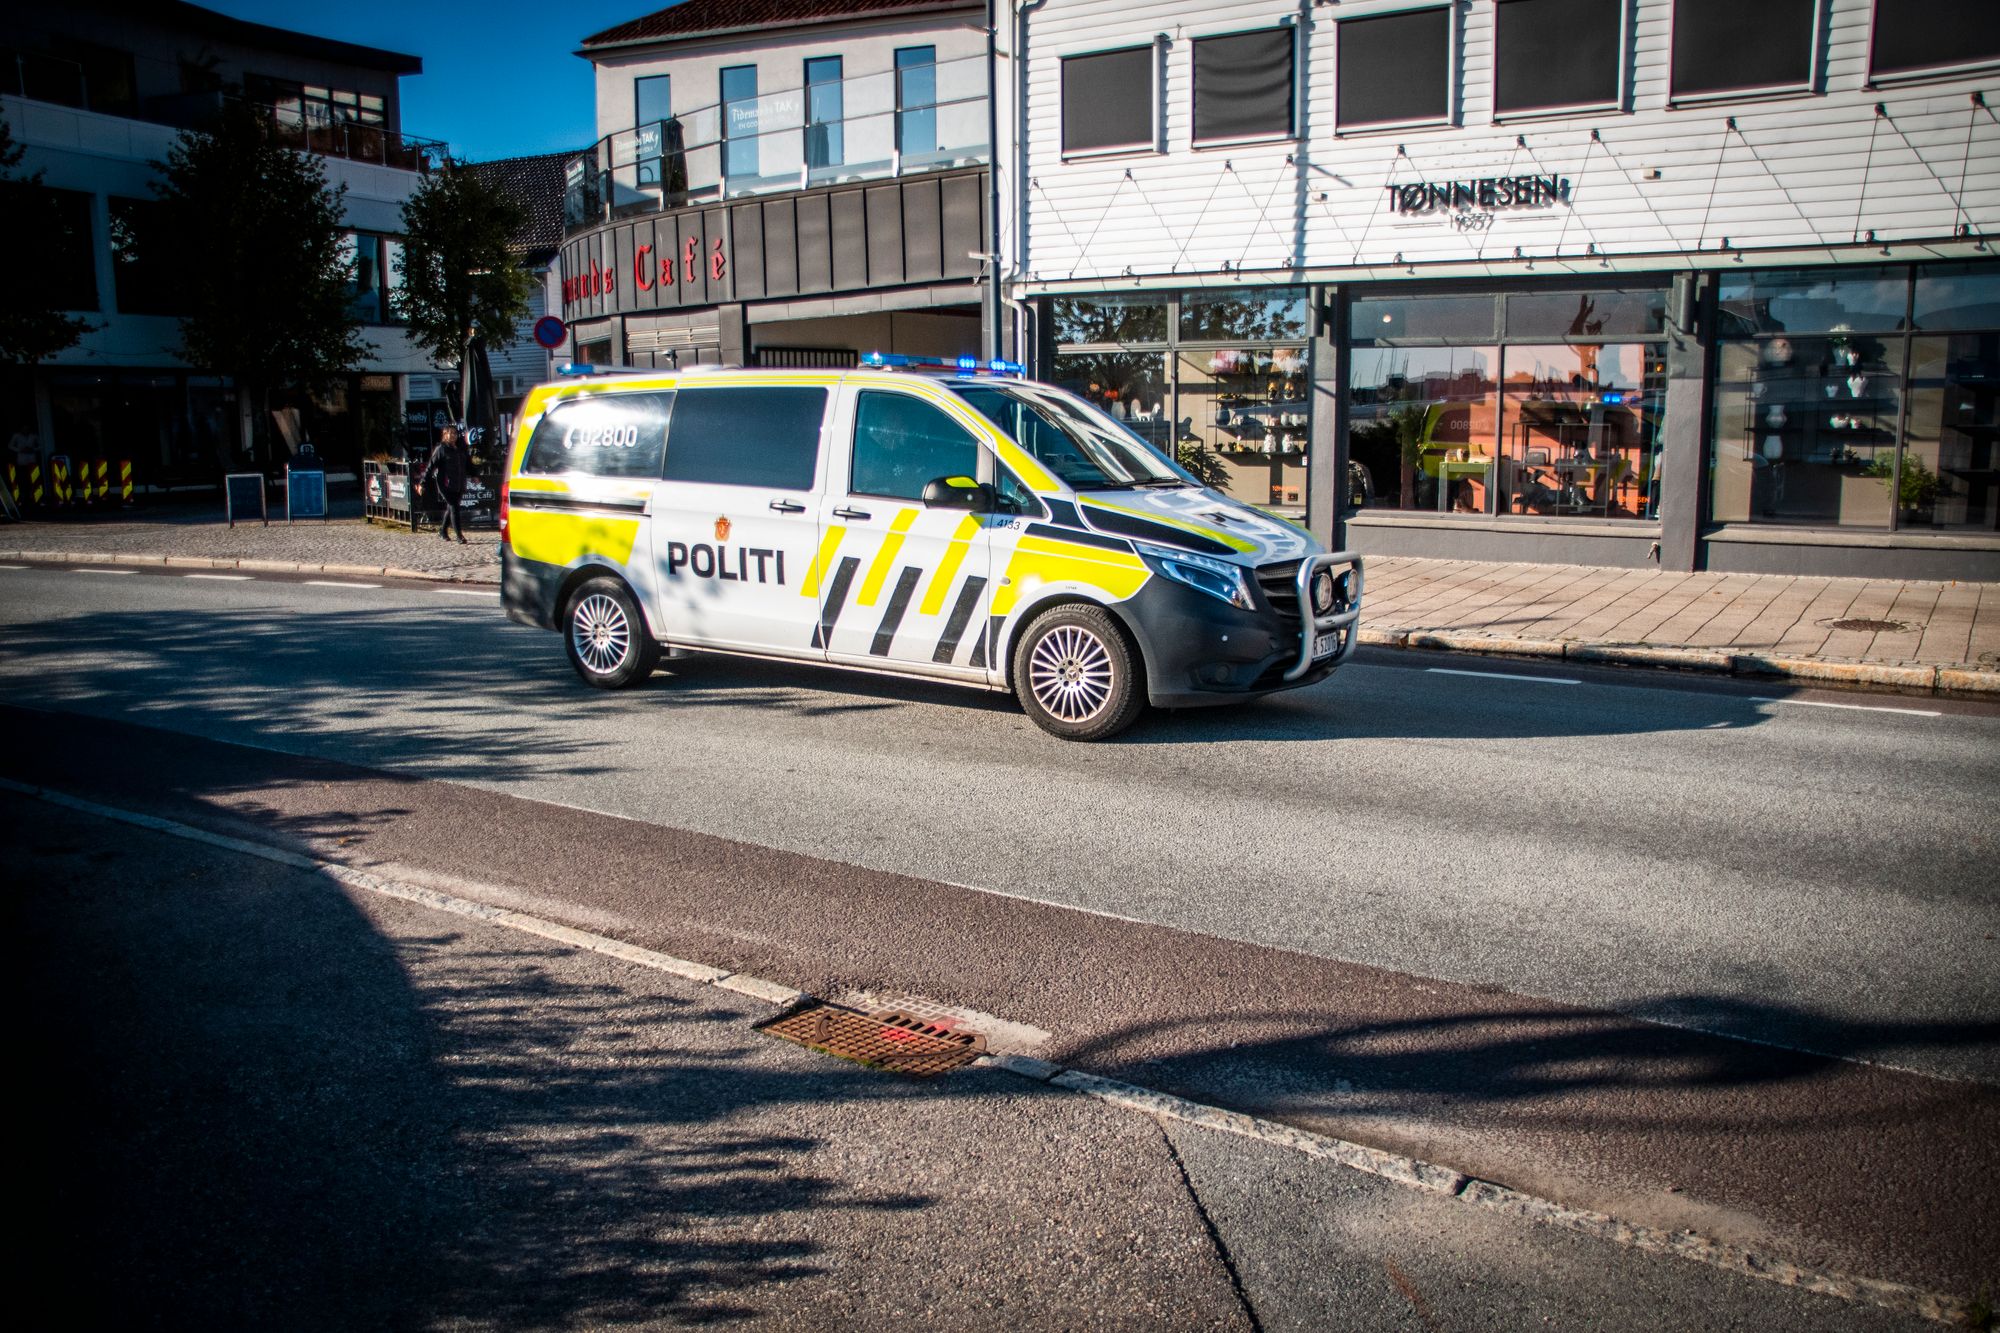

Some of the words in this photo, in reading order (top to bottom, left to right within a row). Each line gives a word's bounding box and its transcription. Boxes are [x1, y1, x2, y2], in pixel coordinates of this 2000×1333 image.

[774, 98, 793, 113] TAK
[641, 131, 655, 144] TAK
[1386, 173, 1558, 213] TØNNESEN
[635, 235, 726, 292] Café
[581, 424, 638, 447] 02800
[997, 519, 1021, 531] 4133
[667, 541, 786, 586] POLITI
